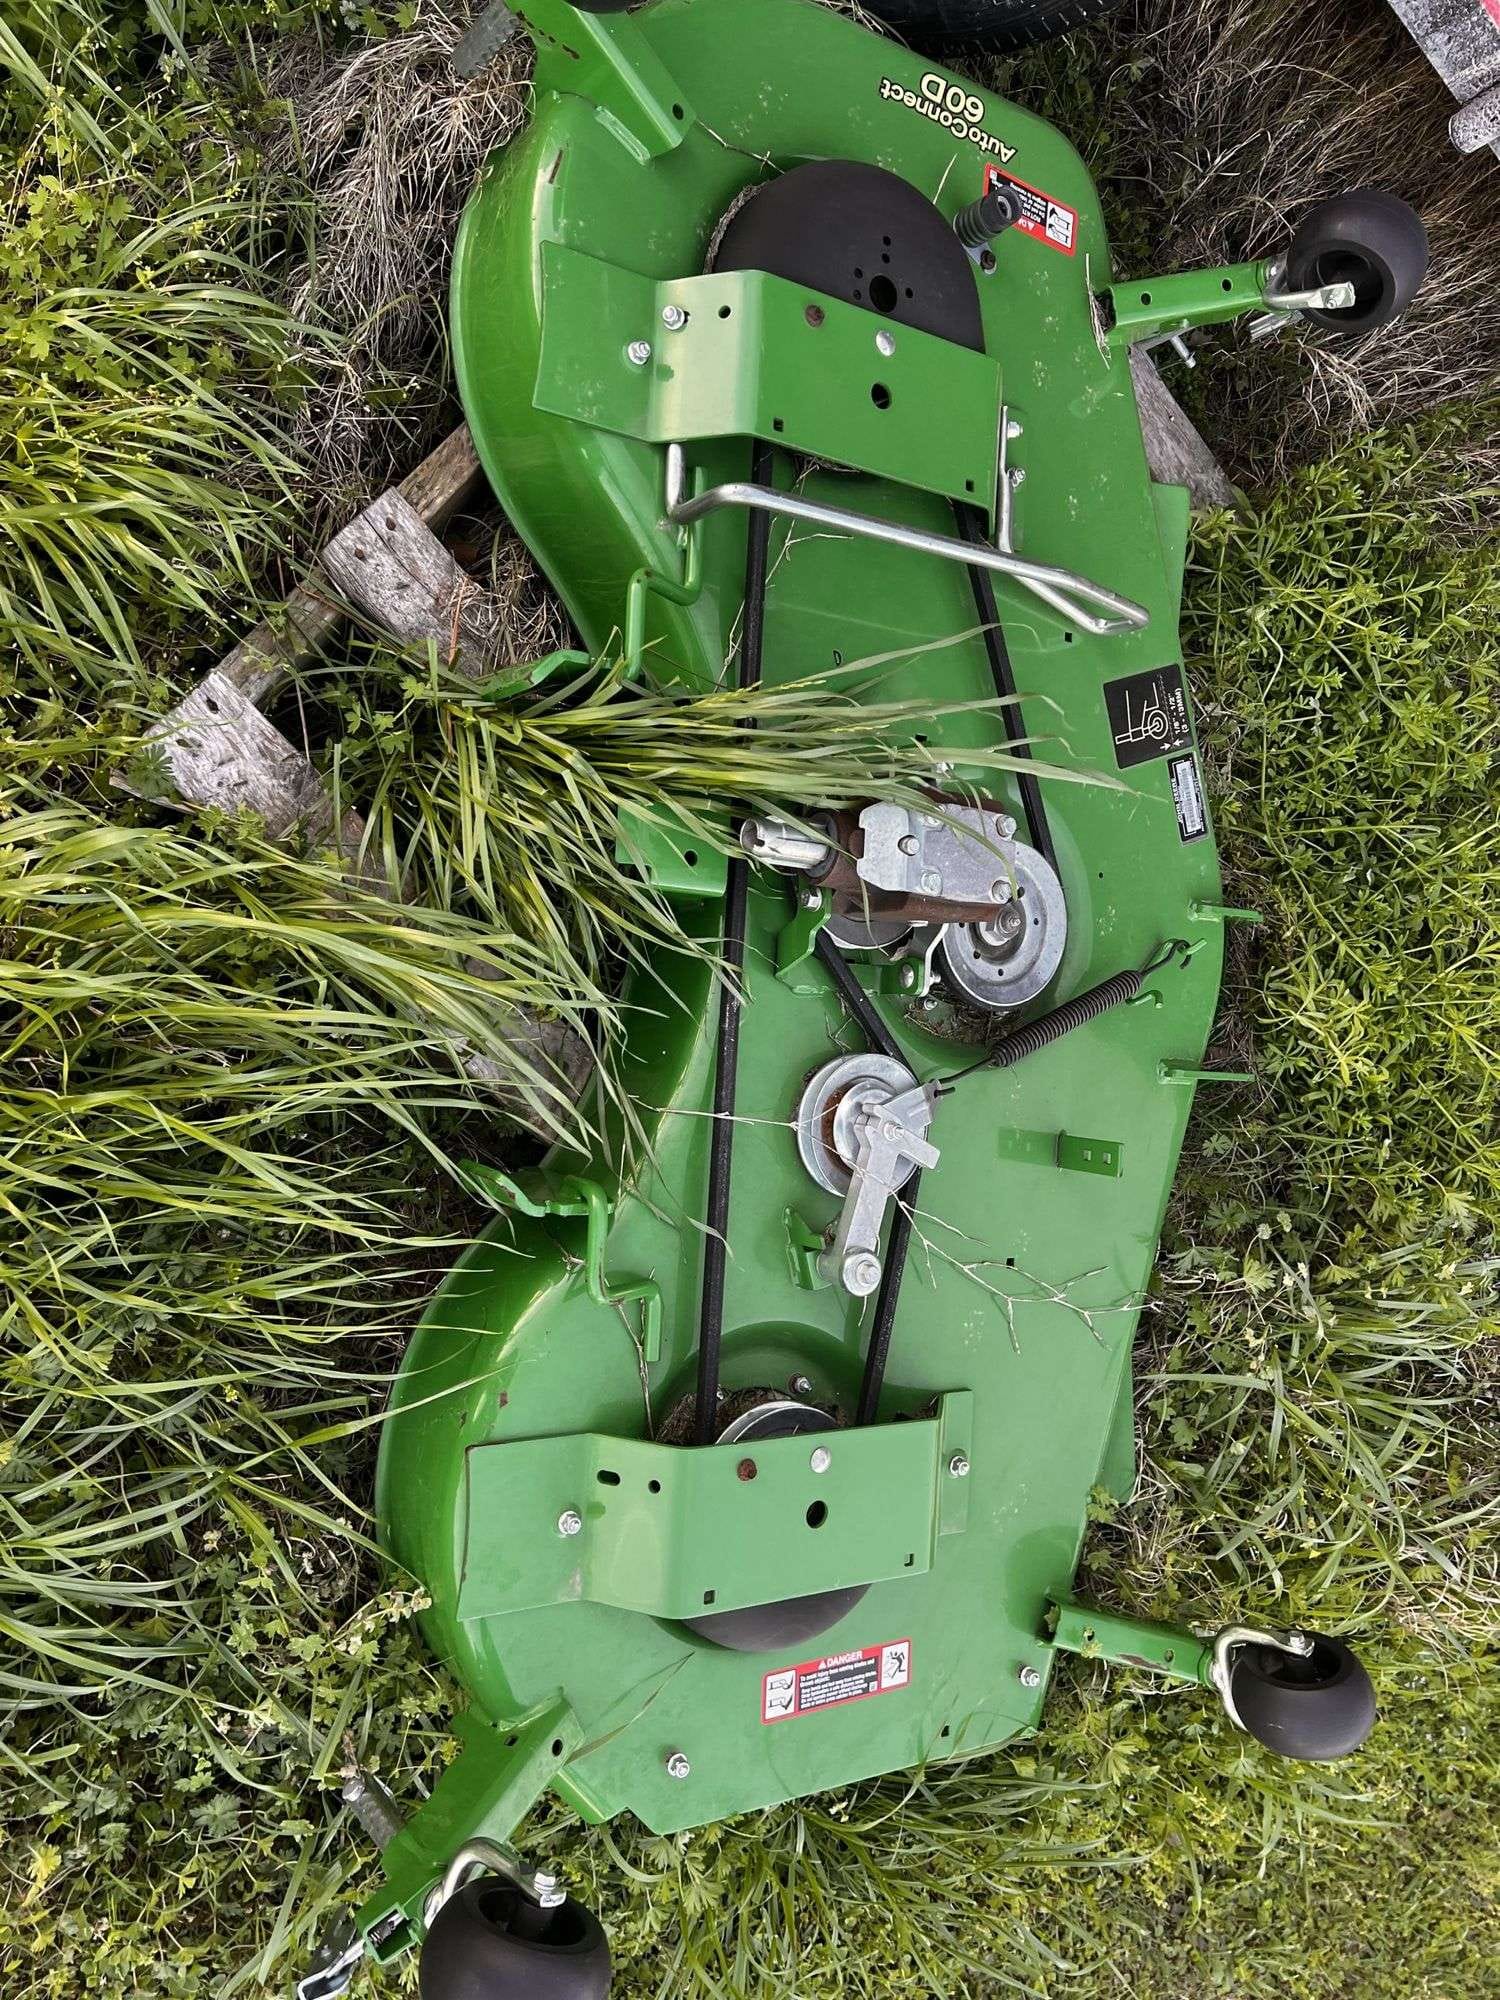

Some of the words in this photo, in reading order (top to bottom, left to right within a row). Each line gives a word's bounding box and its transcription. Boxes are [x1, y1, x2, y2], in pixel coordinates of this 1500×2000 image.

[880, 77, 1018, 164] AutoConnect
[920, 72, 985, 124] 60D
[827, 1650, 863, 1667] DANGER
